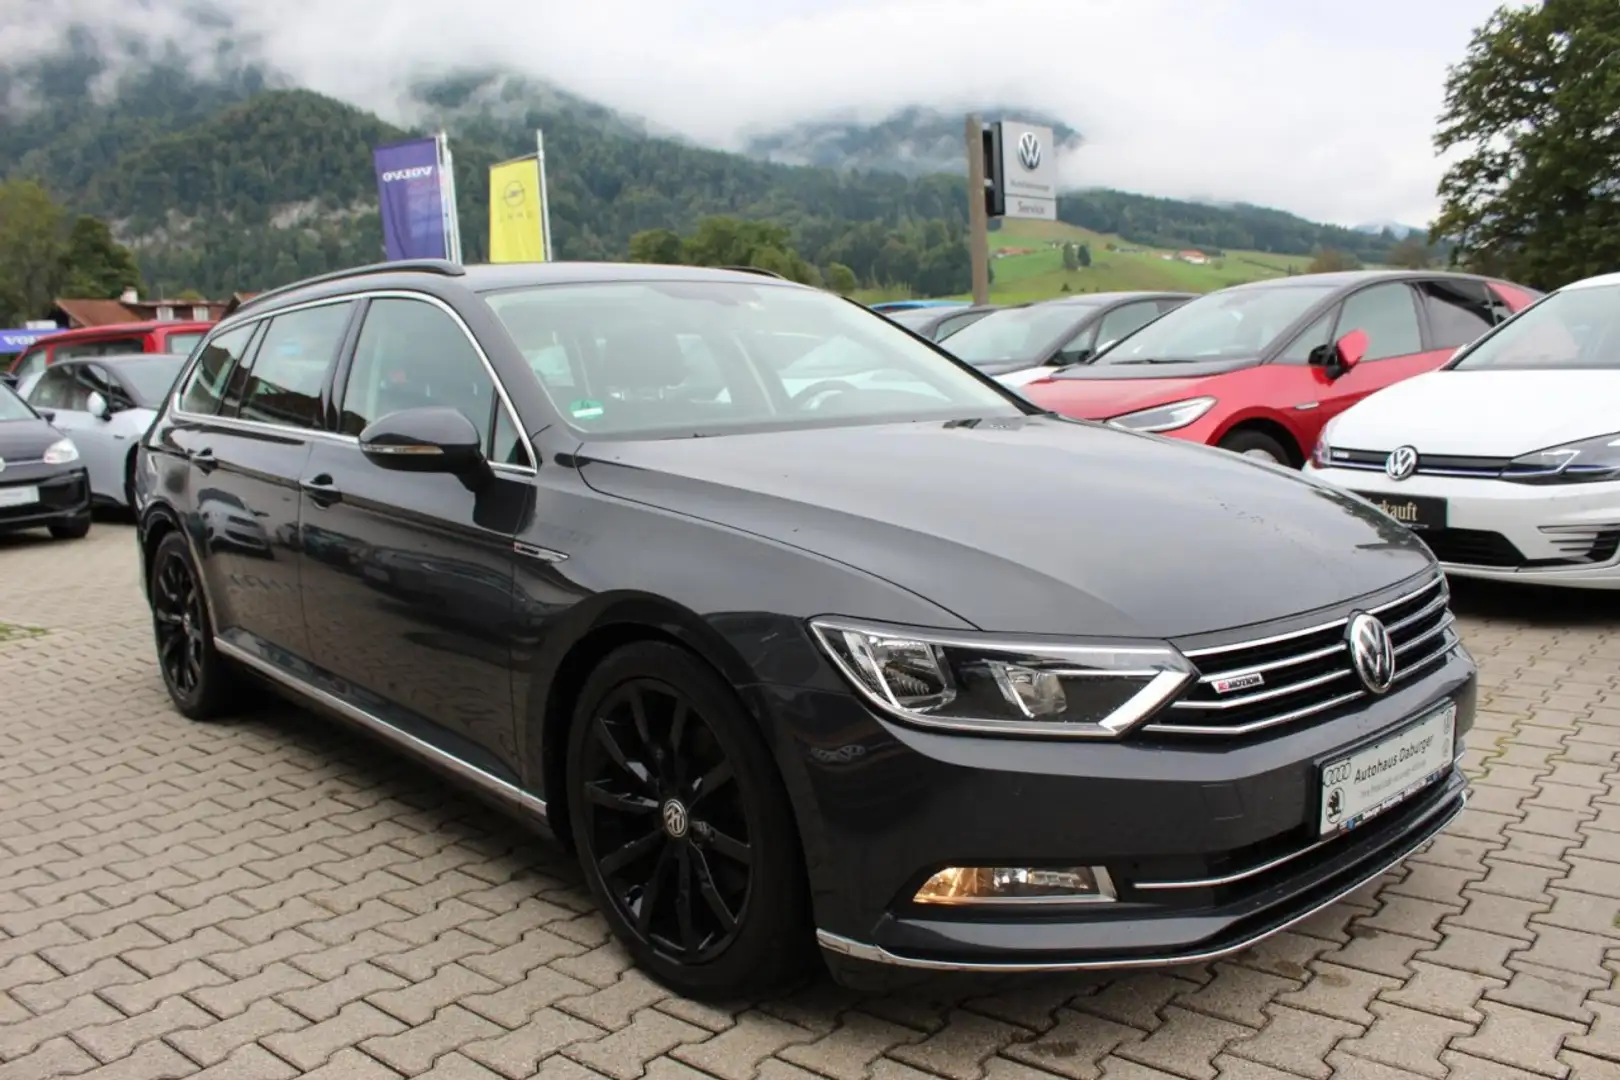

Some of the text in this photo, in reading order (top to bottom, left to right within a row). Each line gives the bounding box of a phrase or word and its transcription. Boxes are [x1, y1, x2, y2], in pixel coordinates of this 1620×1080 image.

[1018, 201, 1046, 215] Service
[1353, 753, 1398, 785] Autohaus
[1399, 734, 1434, 762] Daburger
